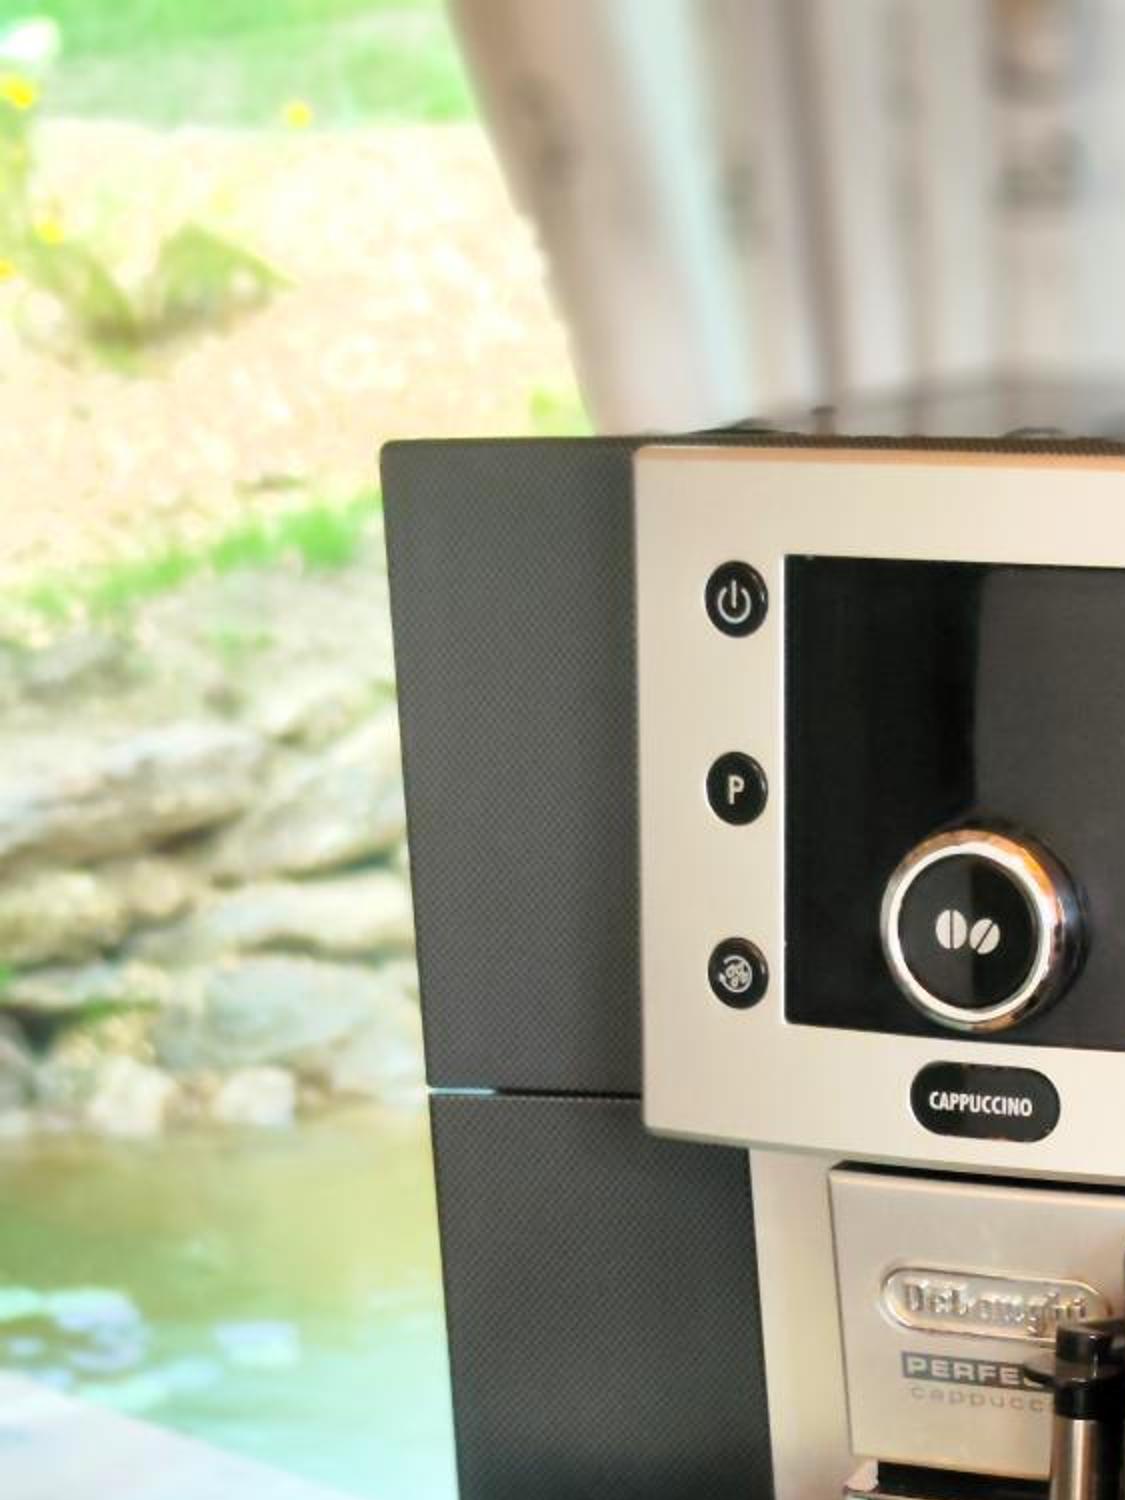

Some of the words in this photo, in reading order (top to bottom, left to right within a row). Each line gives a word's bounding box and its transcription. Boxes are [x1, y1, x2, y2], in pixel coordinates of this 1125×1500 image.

[728, 774, 745, 805] P
[928, 1090, 1033, 1117] CAPPUCCINO
[906, 1355, 1045, 1388] PERFE
